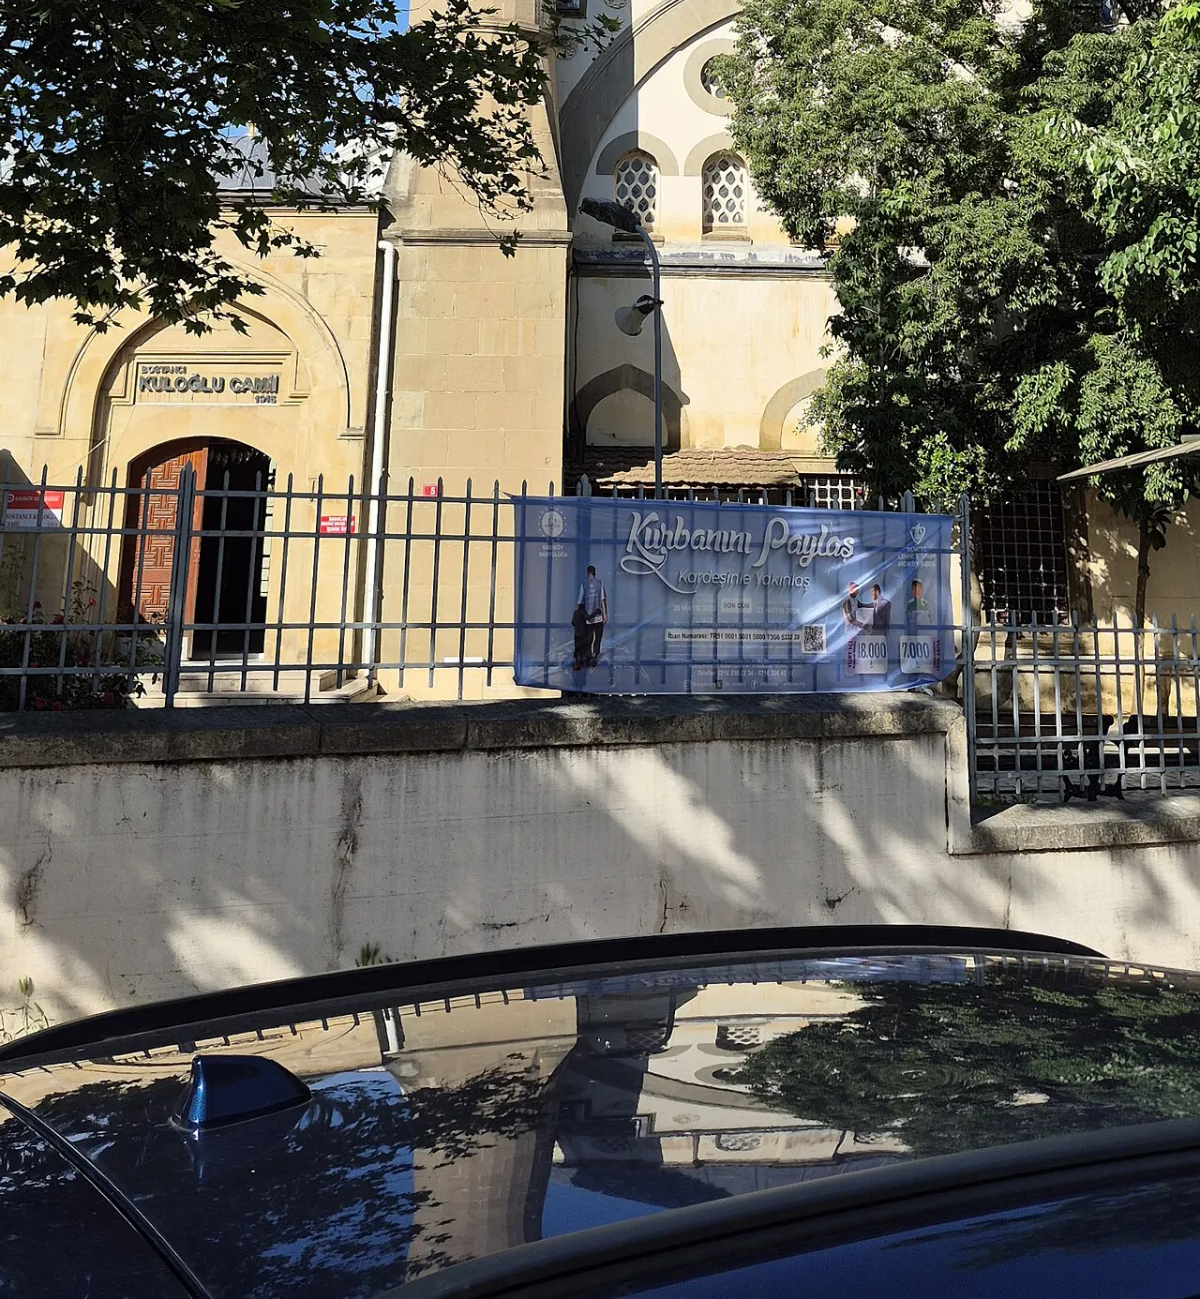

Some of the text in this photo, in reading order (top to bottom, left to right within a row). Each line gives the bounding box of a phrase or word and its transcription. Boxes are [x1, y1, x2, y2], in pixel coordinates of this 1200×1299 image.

[142, 366, 187, 374] BOSTANCI
[139, 374, 225, 393] KULOĞLU
[431, 486, 436, 495] 5
[620, 512, 855, 573] Kurbanın Paylaş
[679, 570, 811, 590] Kardeşinle Yakınlaş
[857, 642, 887, 659] 18.000
[902, 642, 930, 659] 7.000
